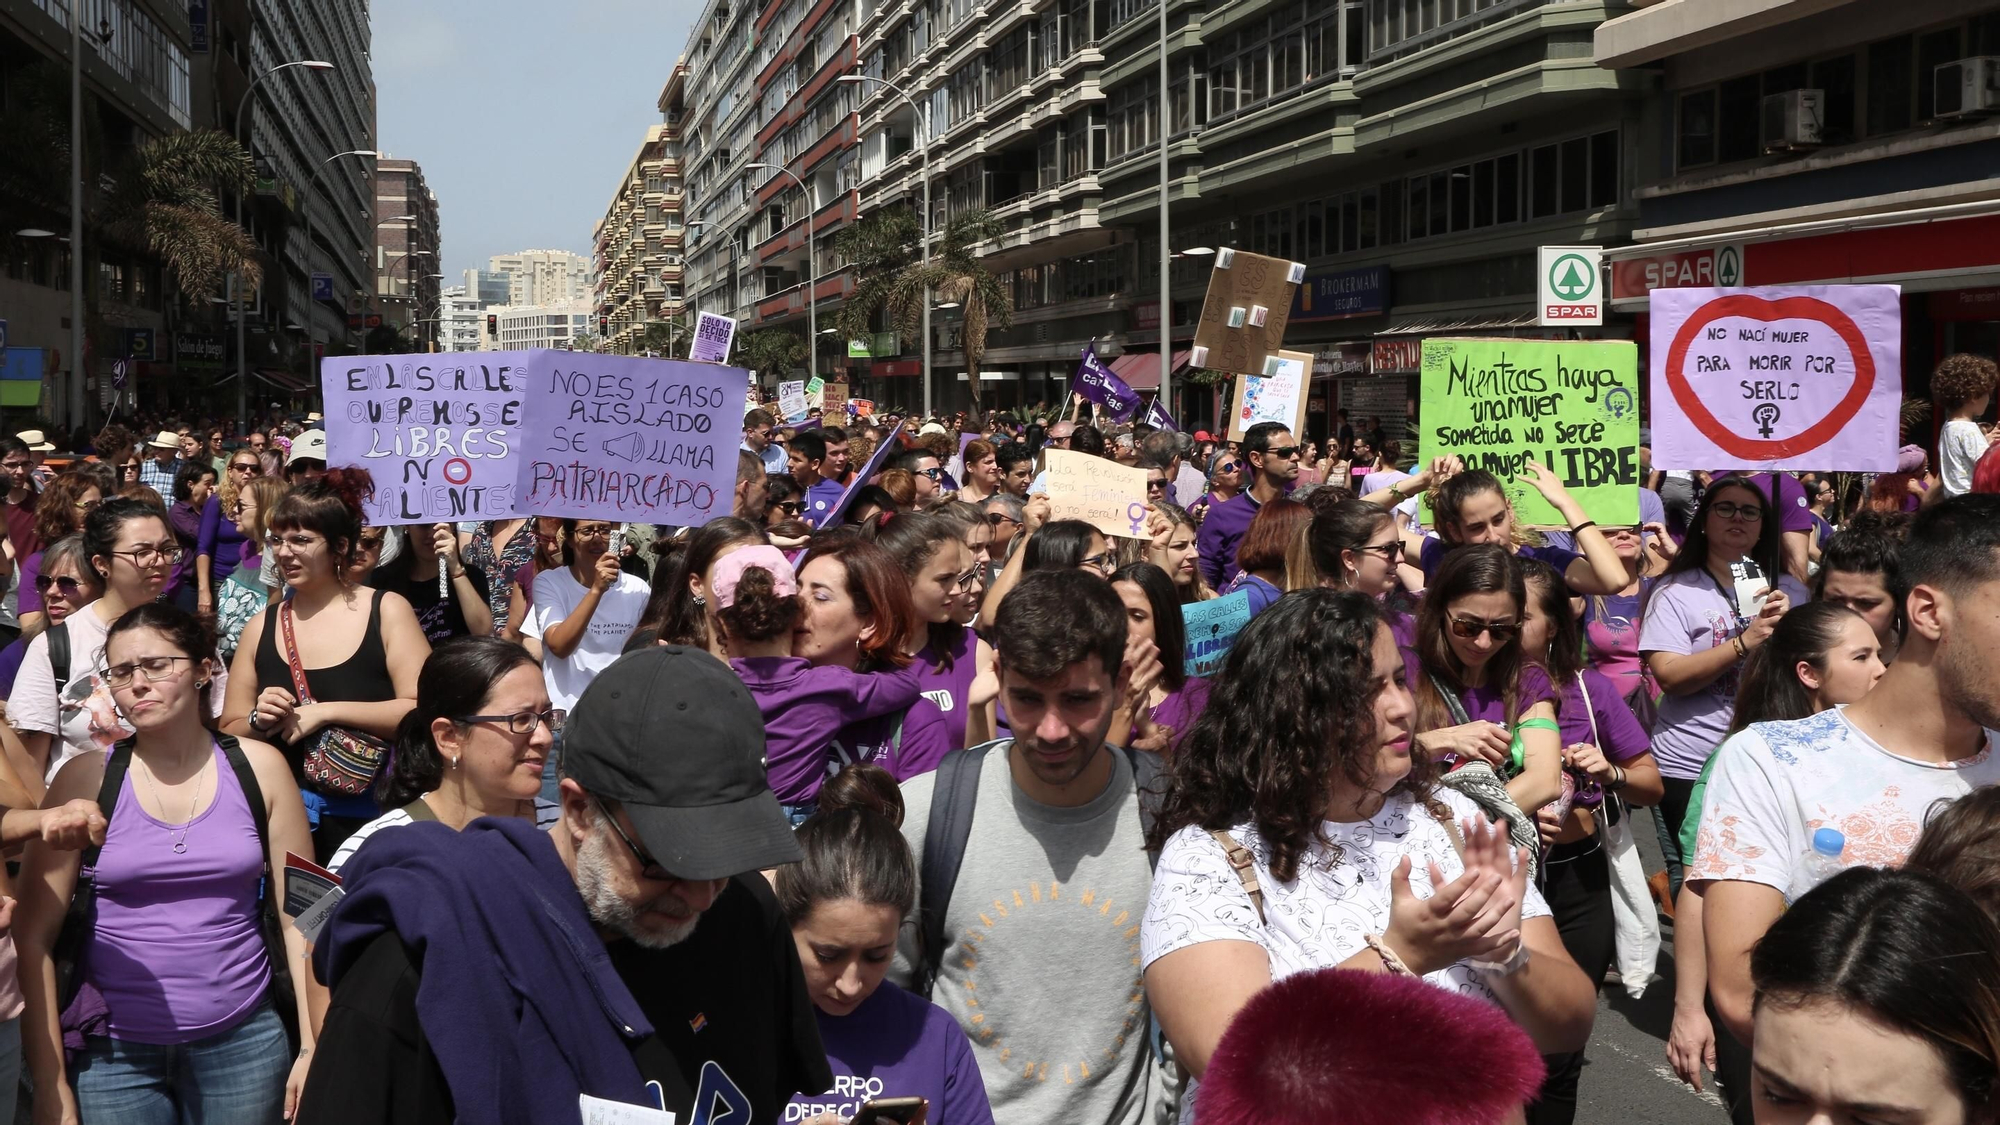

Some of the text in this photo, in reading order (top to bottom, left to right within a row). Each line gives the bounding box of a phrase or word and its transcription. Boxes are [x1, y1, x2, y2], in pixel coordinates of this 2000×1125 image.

[1222, 252, 1234, 267] NO
[1292, 265, 1305, 281] NO
[1645, 256, 1712, 289] SPAR
[313, 280, 325, 294] P
[1335, 297, 1361, 311] SEGUROS
[1548, 307, 1596, 317] SPAR
[702, 316, 731, 330] SOLO YO
[1232, 310, 1245, 325] NO
[1254, 308, 1267, 325] NO
[700, 324, 729, 338] DECIDO
[1707, 327, 1809, 343] NO NACÍ MUJER
[177, 336, 196, 354] Salón
[197, 341, 205, 354] de
[1697, 354, 1835, 374] PARA MORIR POR
[1447, 352, 1548, 397] Mientras
[1557, 354, 1623, 403] haya
[550, 369, 724, 409] NO ES 1 CASO
[781, 383, 792, 396] 8M
[1740, 380, 1800, 400] SERLO
[483, 400, 525, 429] SE
[567, 400, 712, 433] AISLADO
[1470, 393, 1563, 423] una mujer
[361, 426, 510, 459] LIBRES
[546, 426, 714, 471] SE LLAMA
[403, 458, 472, 485] NO
[529, 460, 717, 511] PATRIARCADO
[362, 482, 518, 520] ALIENTE
[1067, 505, 1080, 514] no
[1184, 598, 1247, 625] LAS CALLES
